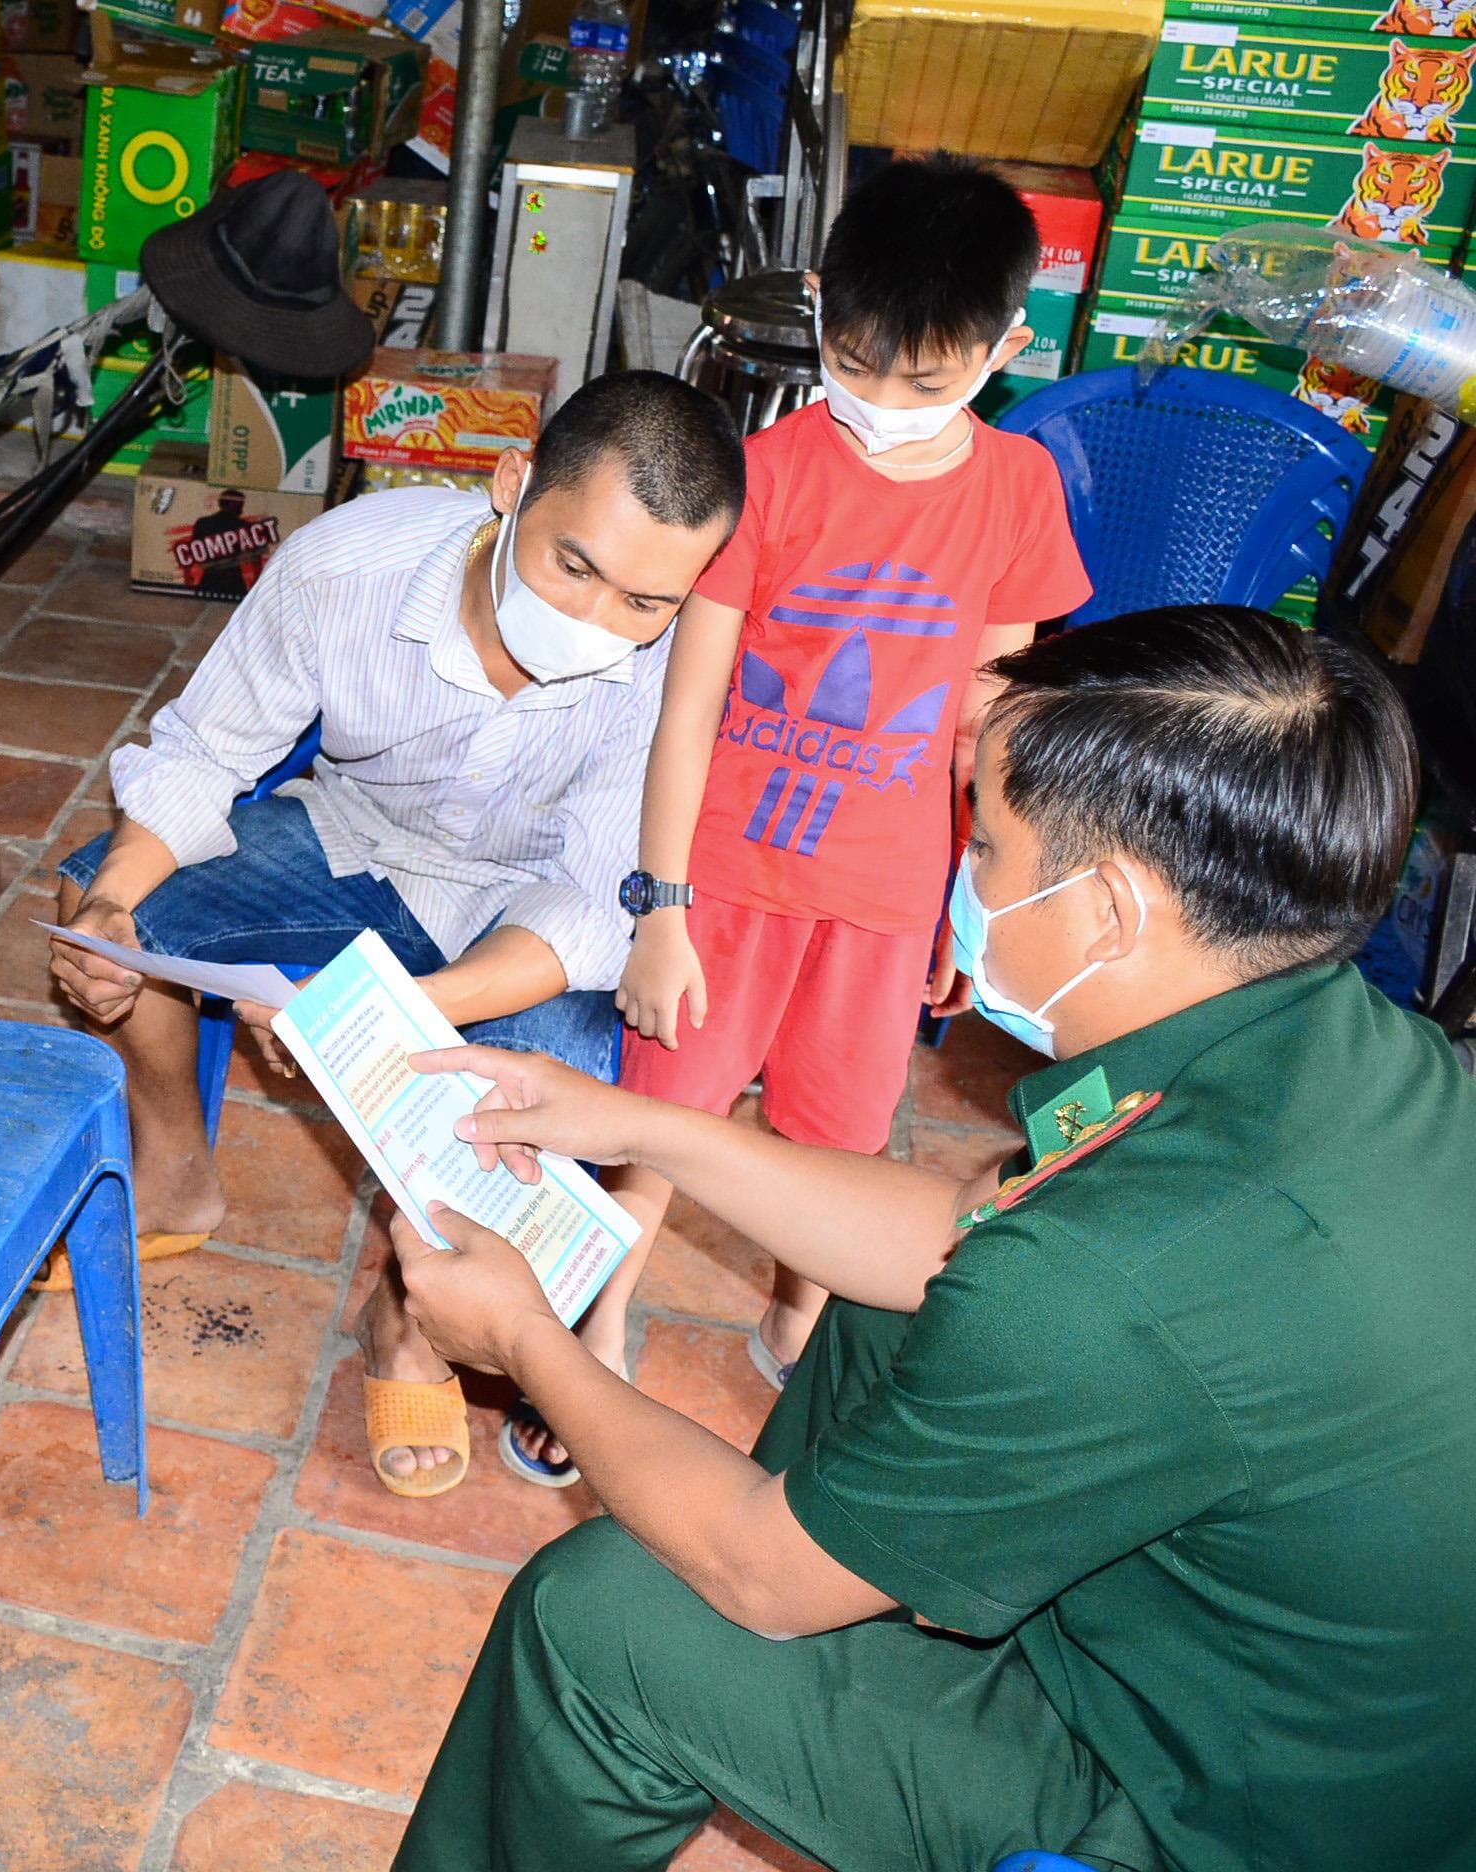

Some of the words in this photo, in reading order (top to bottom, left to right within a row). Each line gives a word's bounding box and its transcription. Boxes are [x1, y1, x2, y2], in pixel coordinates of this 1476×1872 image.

[1180, 45, 1339, 83] LARUE
[1202, 76, 1302, 97] SPECIAL
[96, 113, 112, 160] XANH
[1159, 146, 1314, 184] LARUE
[92, 163, 111, 221] KHÔNG
[1180, 176, 1278, 198] SPECIAL
[1058, 248, 1081, 263] LON
[364, 388, 445, 436] MIRINDA
[175, 519, 279, 567] COMPACT
[517, 1223, 544, 1253] 9003228
